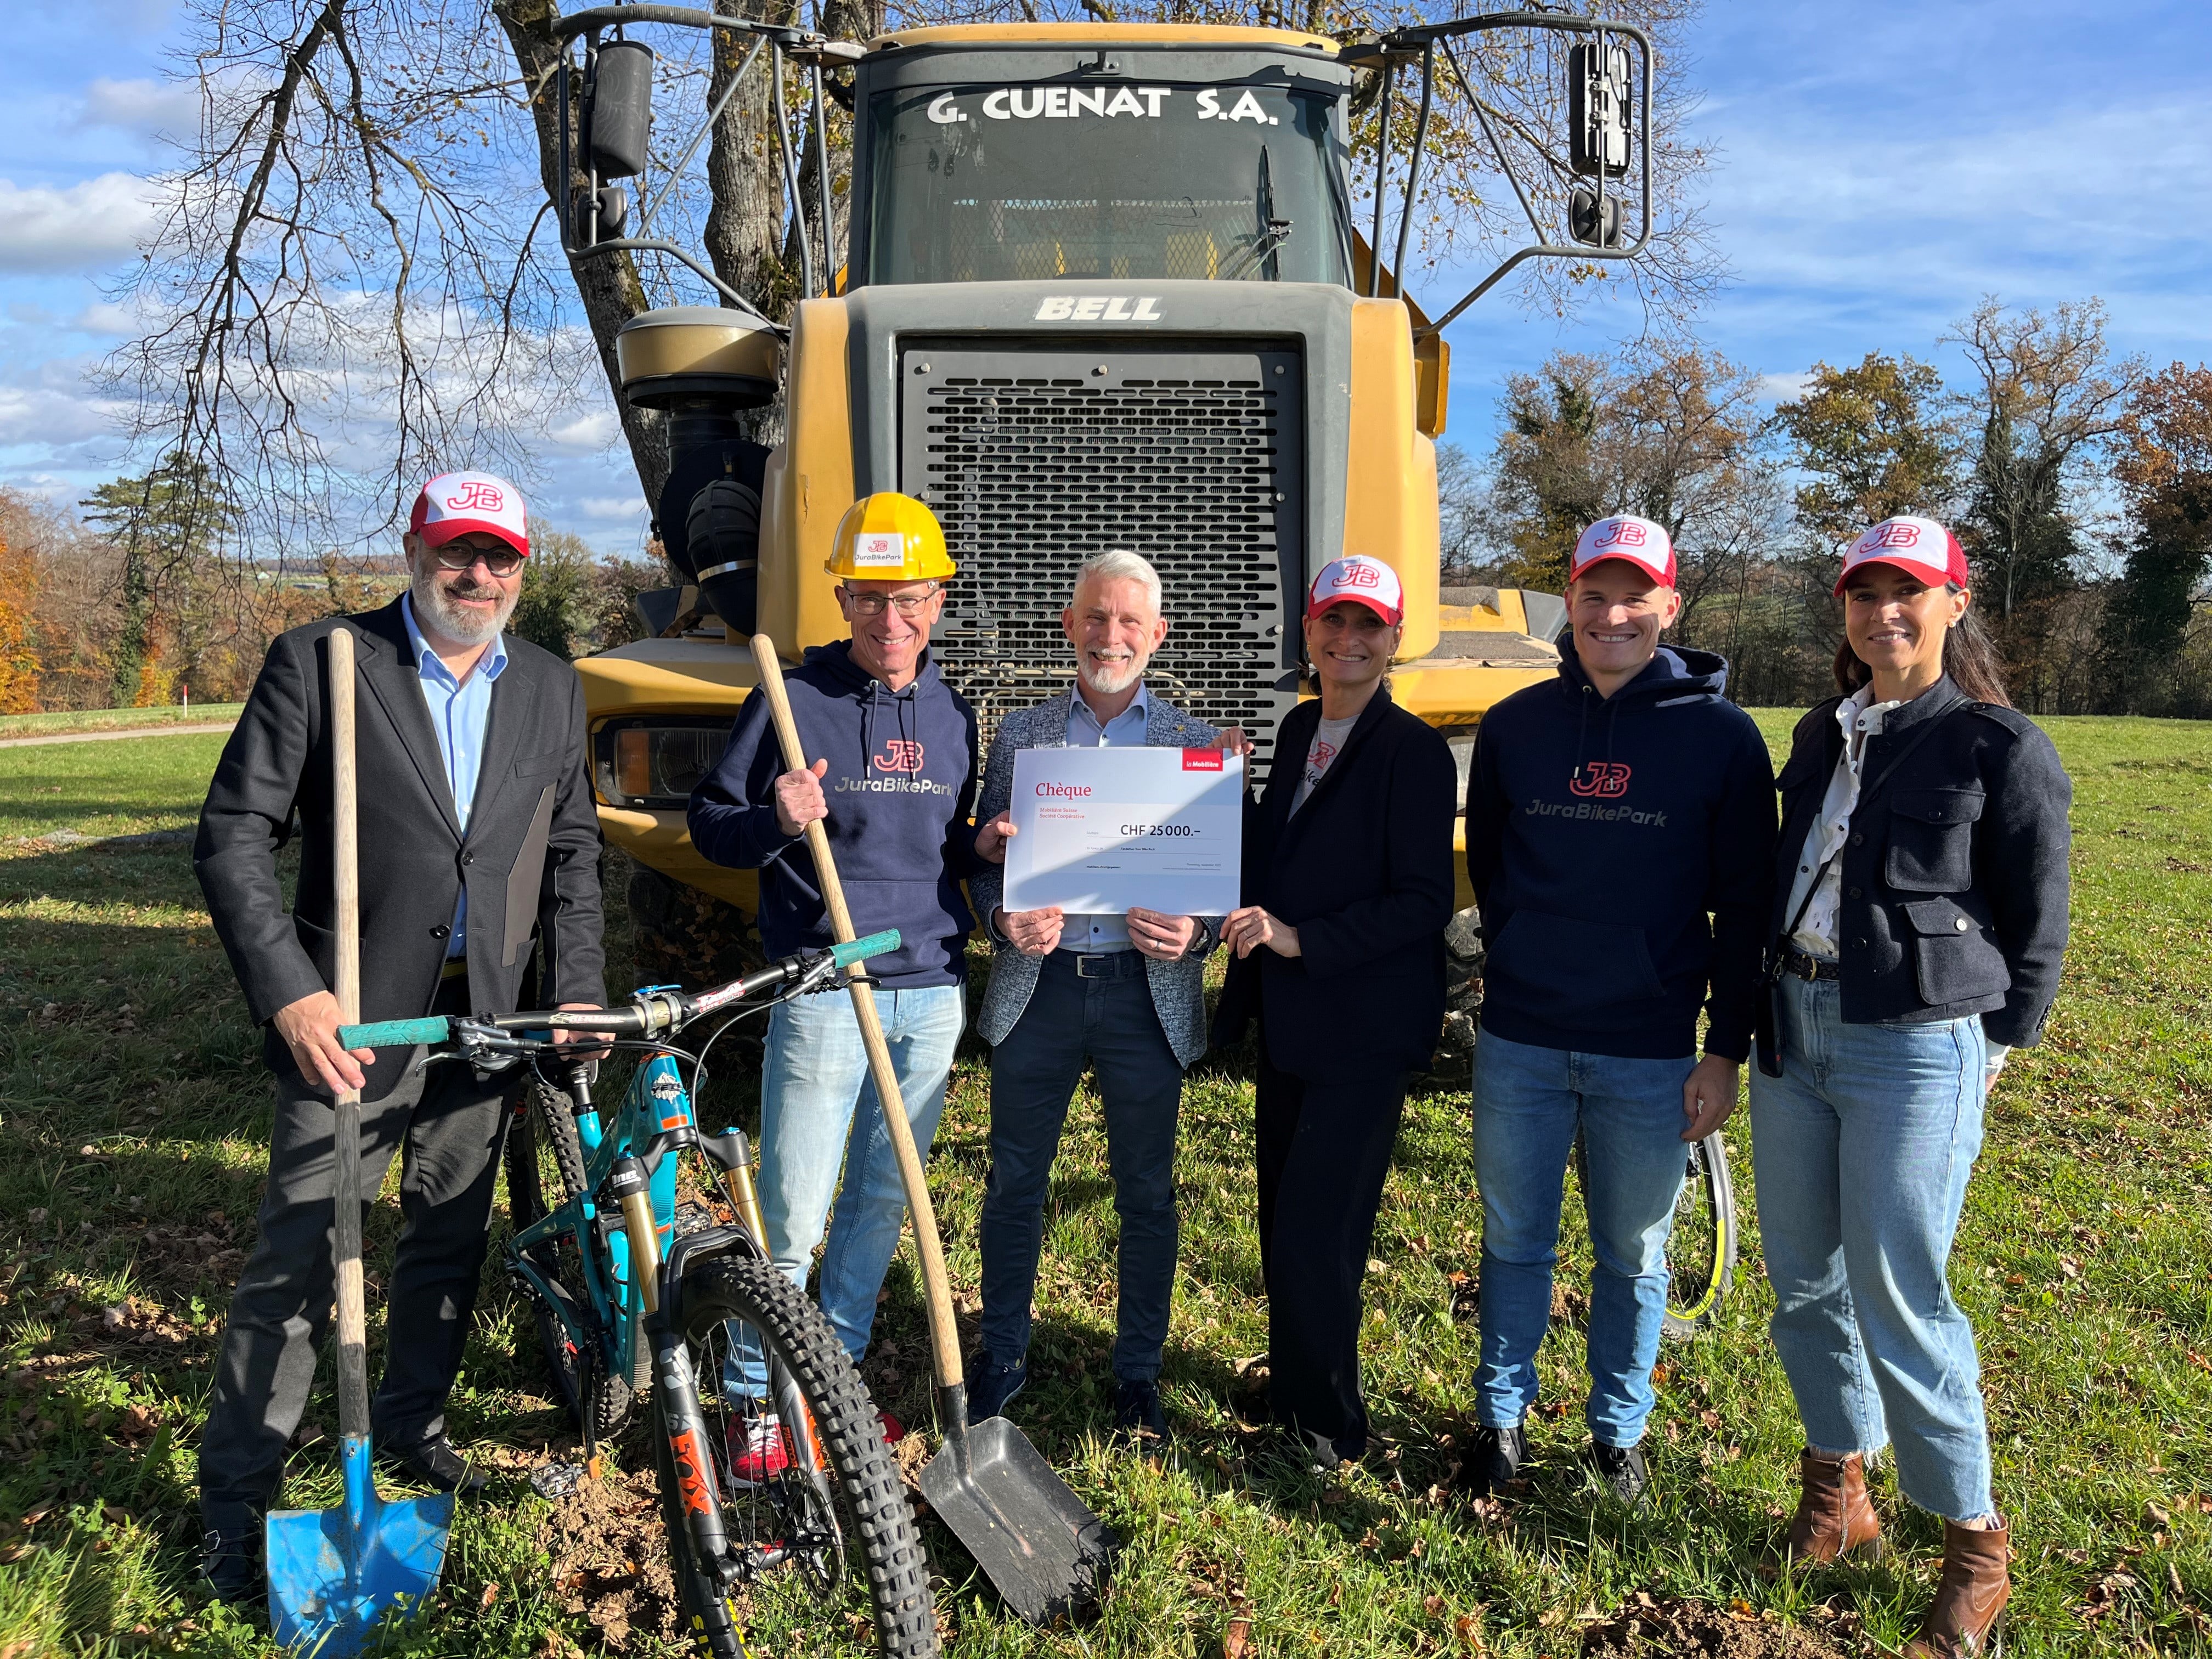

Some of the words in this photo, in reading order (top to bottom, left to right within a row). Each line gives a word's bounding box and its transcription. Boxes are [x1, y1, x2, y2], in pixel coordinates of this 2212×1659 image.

[927, 91, 967, 124] G.
[982, 86, 1171, 120] CUENAT
[1196, 89, 1279, 126] S.A.
[1035, 296, 1163, 321] BELL
[447, 482, 503, 512] JB
[868, 540, 888, 552] JB
[1594, 522, 1647, 548] JB
[1859, 523, 1921, 554] JB
[1331, 565, 1380, 589] JB
[834, 777, 952, 797] JuraBikePark
[1036, 782, 1091, 800] Chèque
[1525, 799, 1668, 827] JuraBikePark
[1120, 825, 1146, 836] CHF
[669, 1429, 714, 1519] FOX
